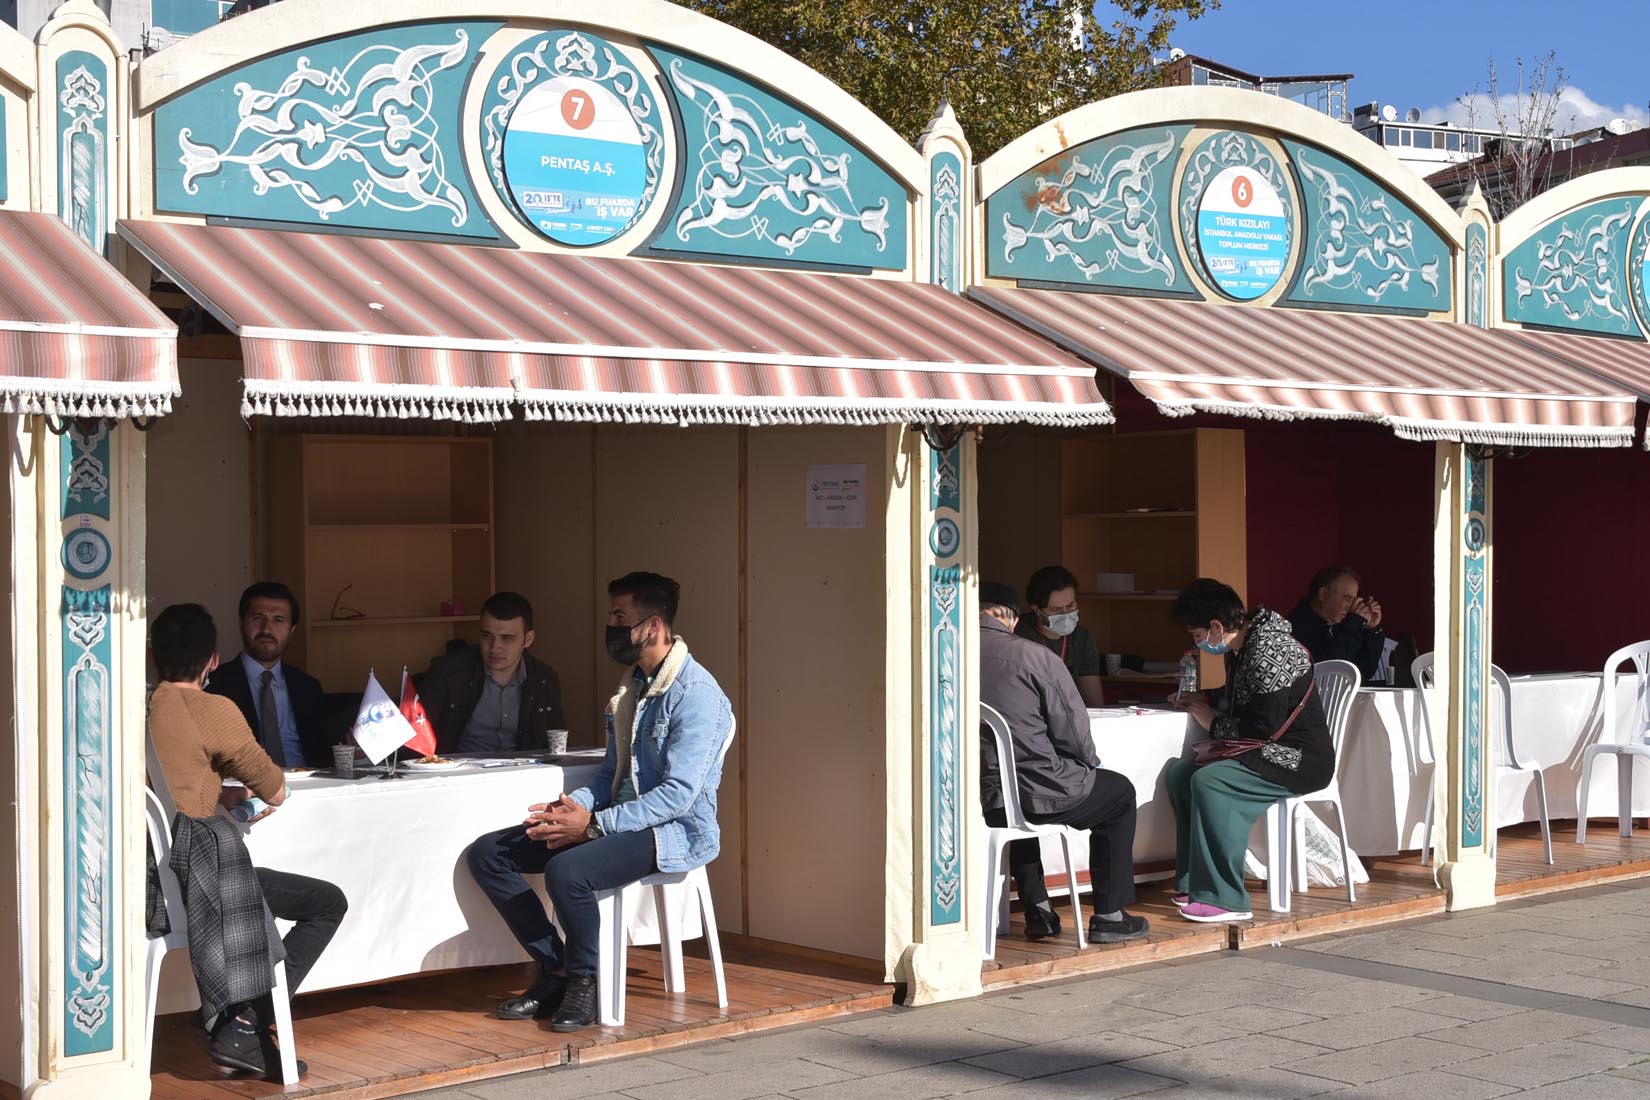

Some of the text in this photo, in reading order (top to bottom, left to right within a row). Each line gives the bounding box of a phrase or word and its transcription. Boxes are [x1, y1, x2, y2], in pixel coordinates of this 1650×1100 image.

[571, 96, 585, 121] 7
[541, 155, 616, 177] PENTAŞ A.Ş.
[1237, 182, 1248, 201] 6
[585, 198, 635, 207] BU FUARDA
[610, 207, 634, 217] VAR
[1216, 215, 1270, 230] TÜRK KIZILAYI
[1204, 227, 1283, 241] İSTANBUL ANADOLU YAKASI
[1218, 240, 1269, 251] TOPLUM MERKEZİ
